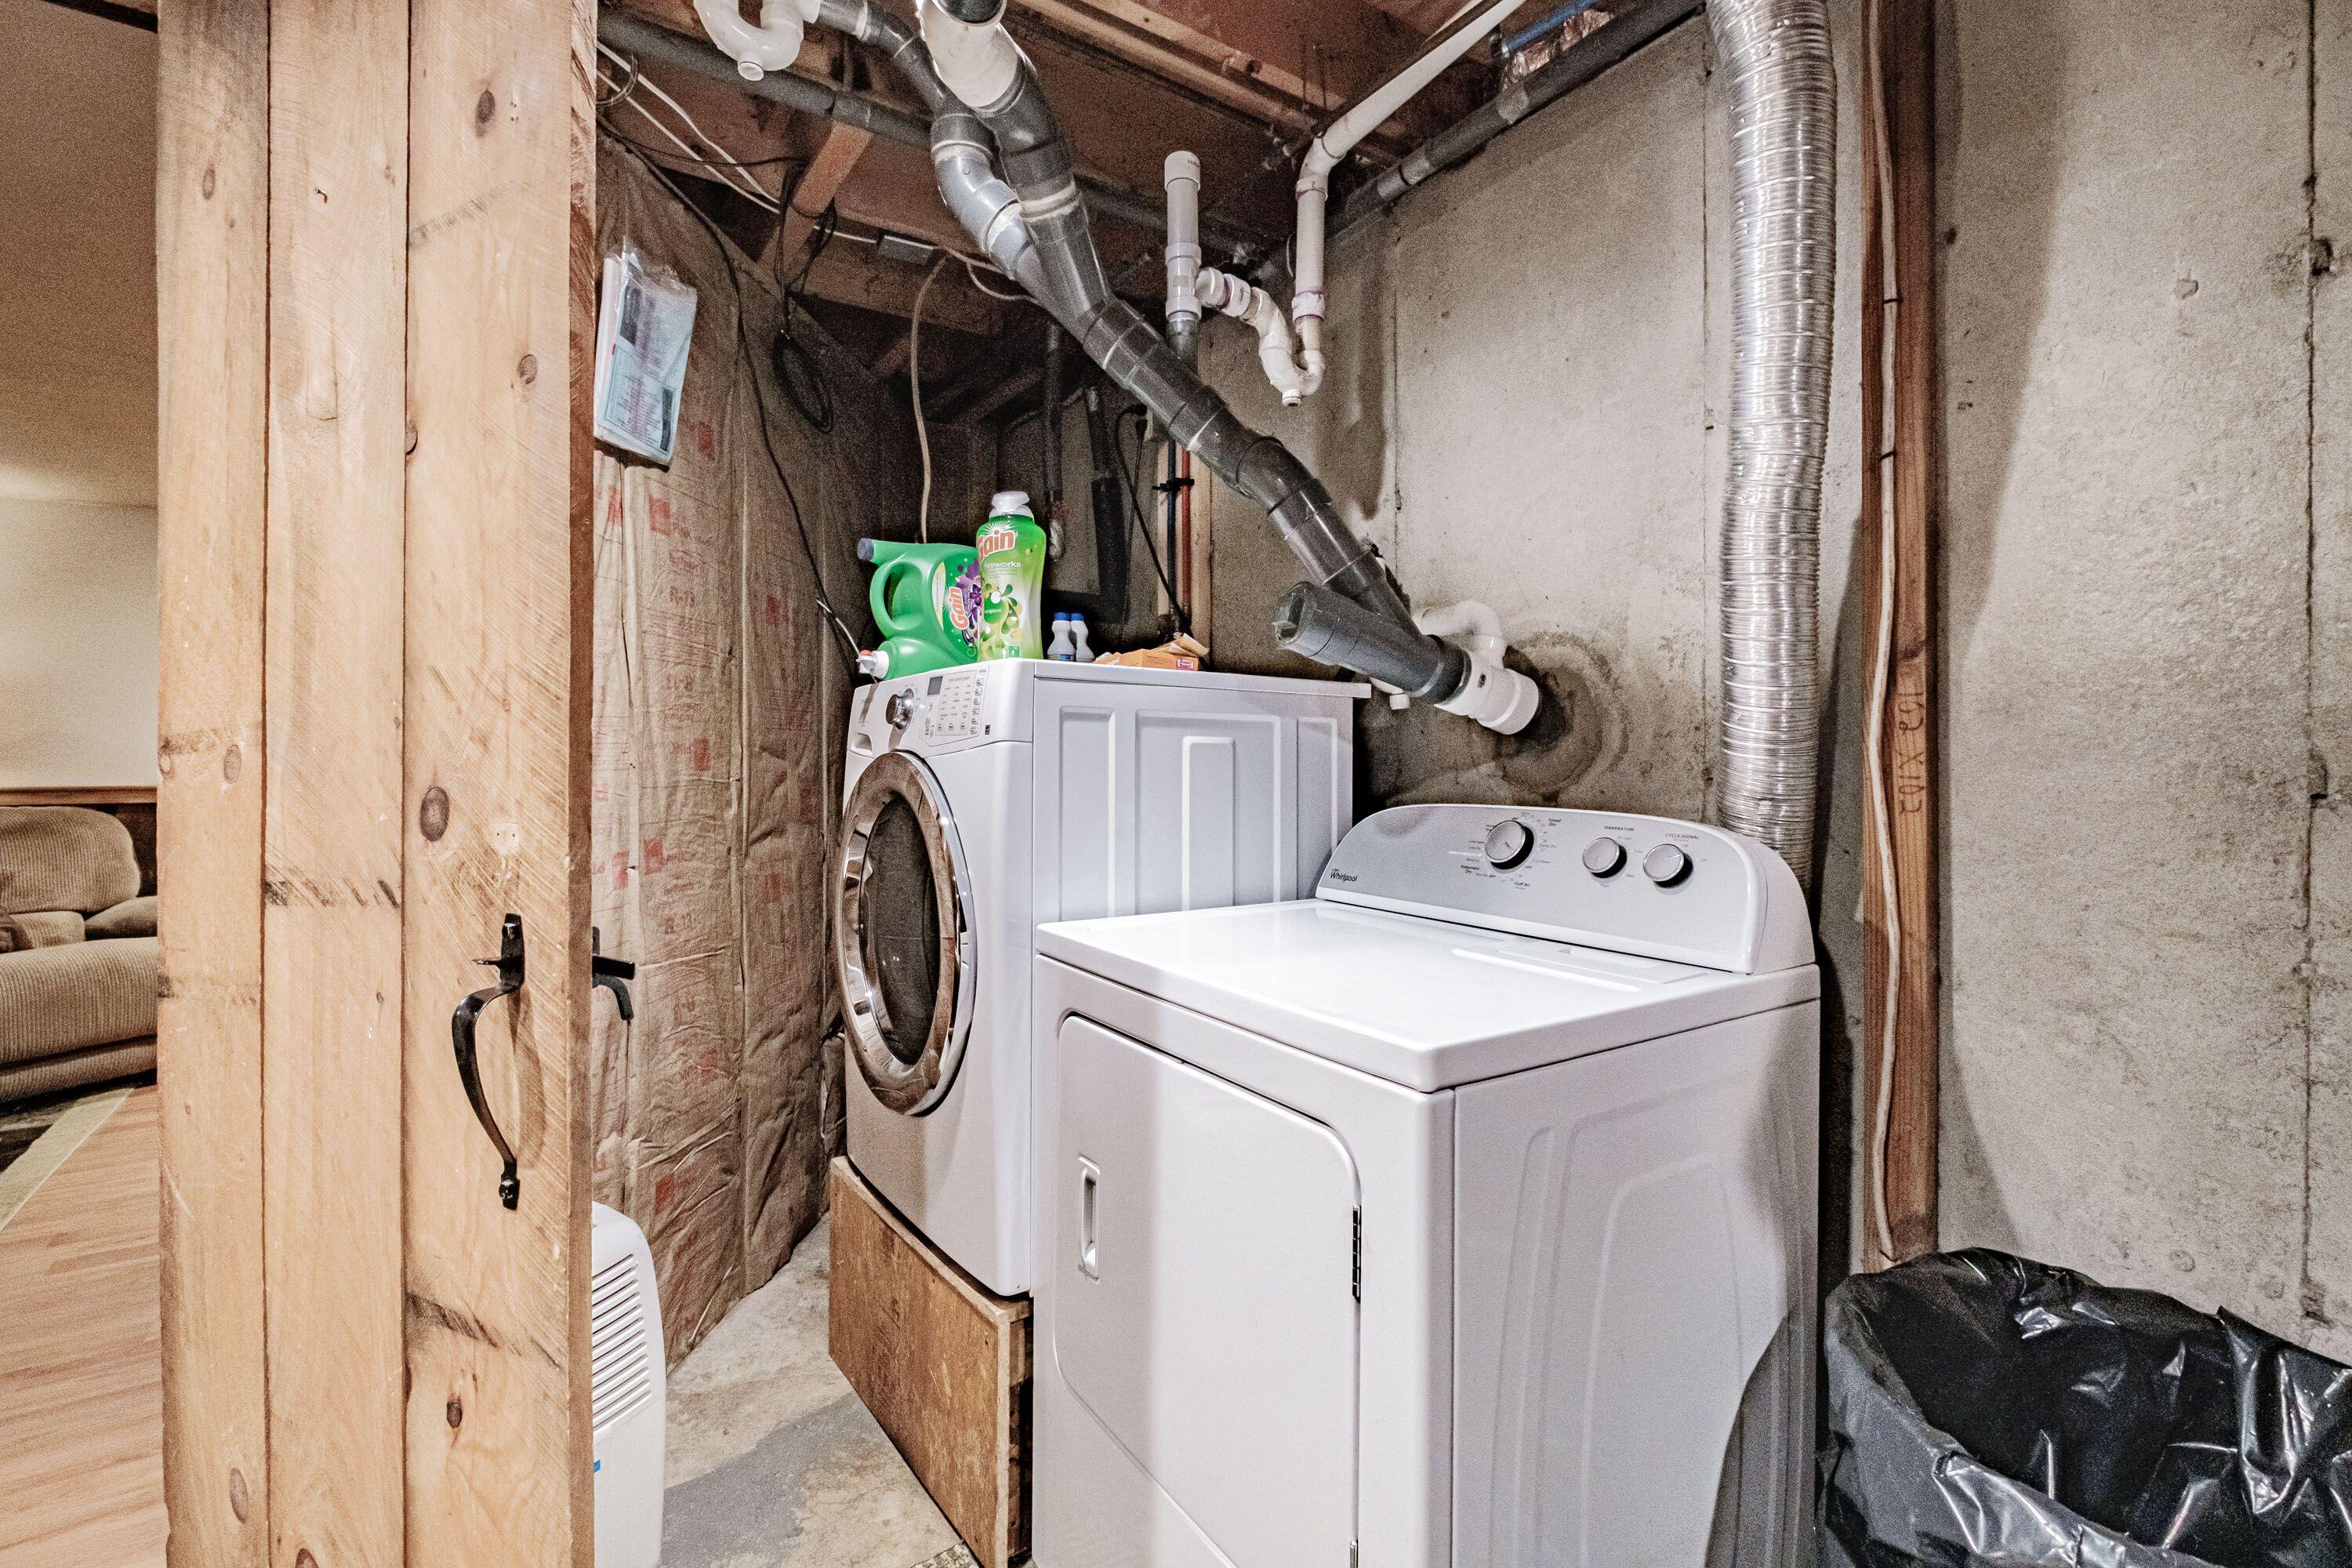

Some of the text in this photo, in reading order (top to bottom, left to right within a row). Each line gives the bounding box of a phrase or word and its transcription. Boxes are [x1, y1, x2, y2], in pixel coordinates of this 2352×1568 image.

[977, 530, 1015, 564] Gain
[984, 560, 1022, 572] fireworks
[950, 586, 969, 630] Gain
[1330, 870, 1359, 884] Whirlpool
